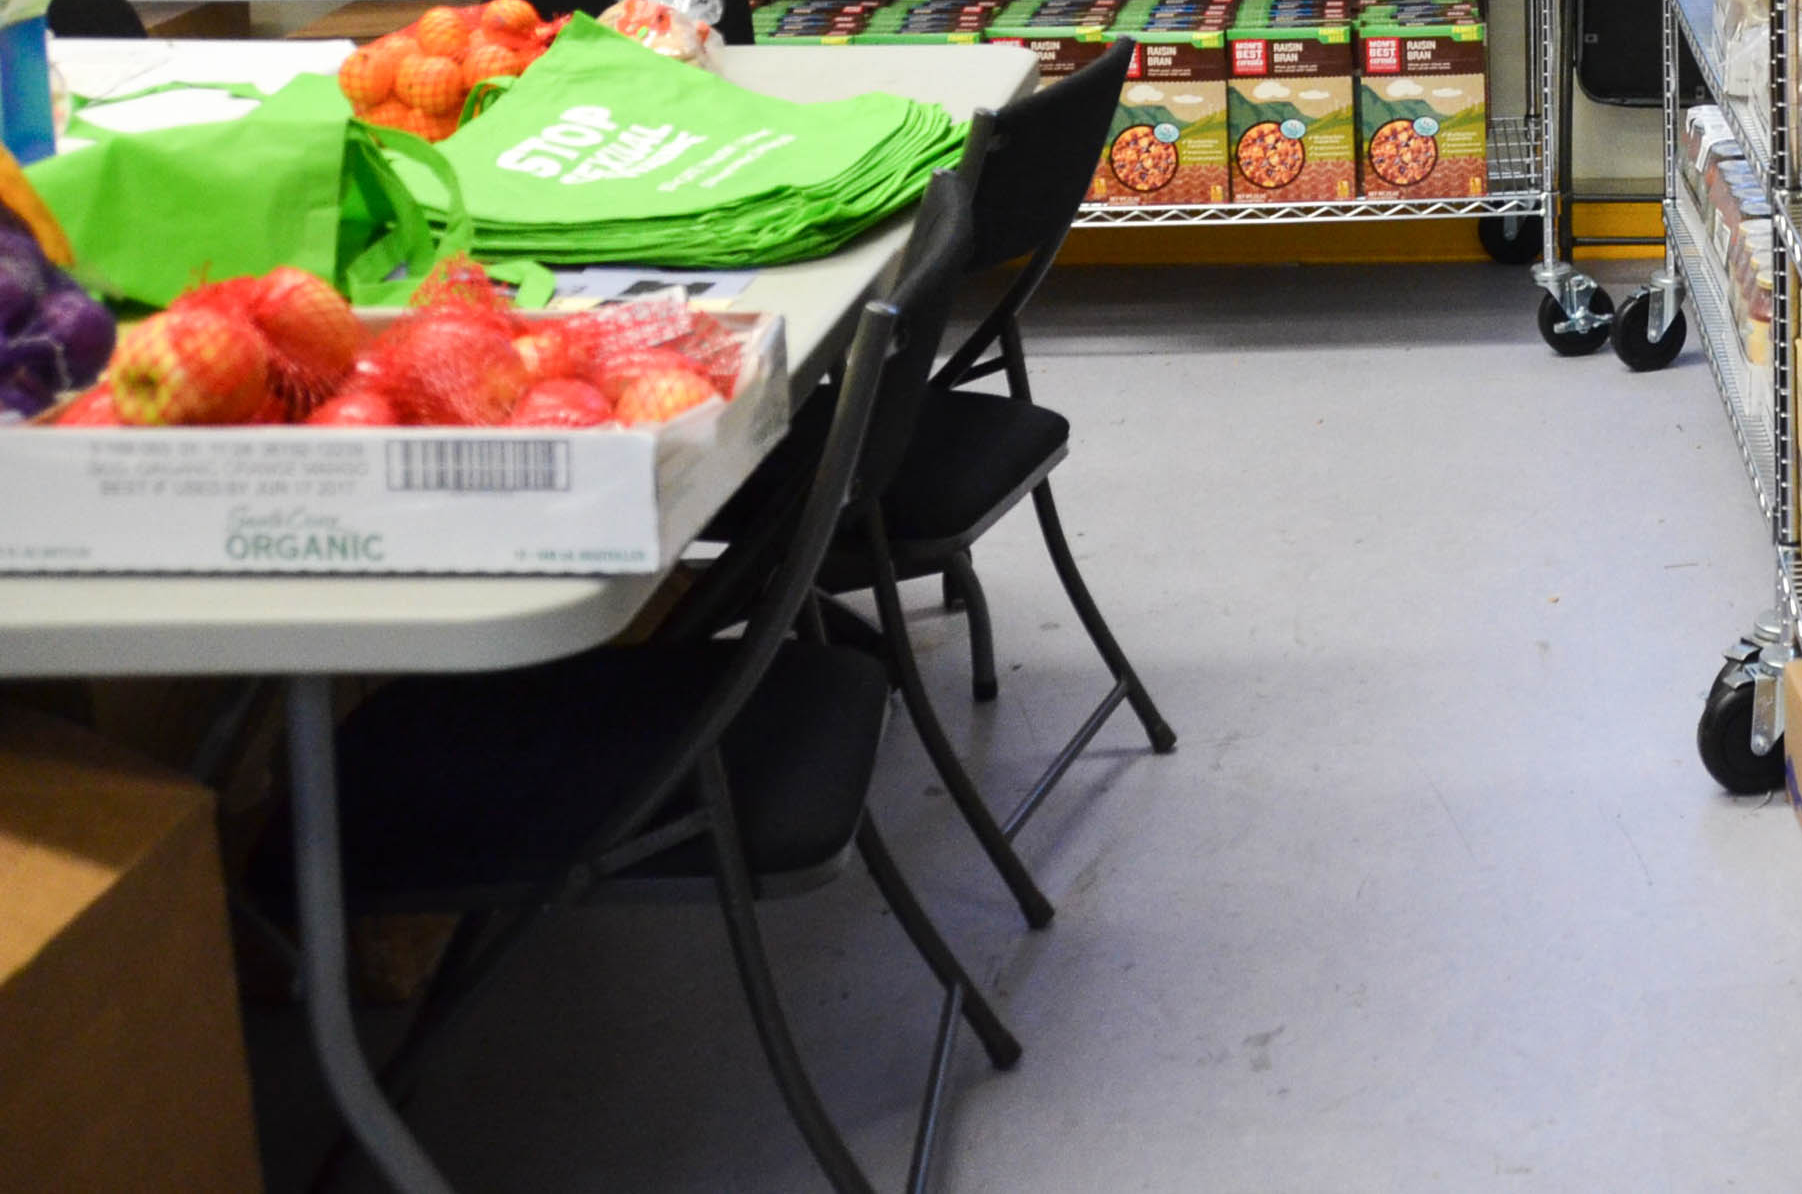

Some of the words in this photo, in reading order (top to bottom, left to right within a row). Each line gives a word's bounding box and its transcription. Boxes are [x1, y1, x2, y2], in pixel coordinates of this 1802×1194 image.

[1031, 41, 1061, 52] RAISIN
[1147, 45, 1177, 57] RAISIN
[1273, 42, 1304, 53] RAISIN
[1406, 40, 1437, 51] RAISIN
[1235, 49, 1264, 60] BEST
[1369, 47, 1397, 57] BEST
[1406, 50, 1432, 61] BRAN
[1147, 56, 1172, 67] BRAN
[1273, 53, 1299, 64] BRAN
[496, 104, 619, 179] STOP
[225, 532, 385, 562] ORGANIC
